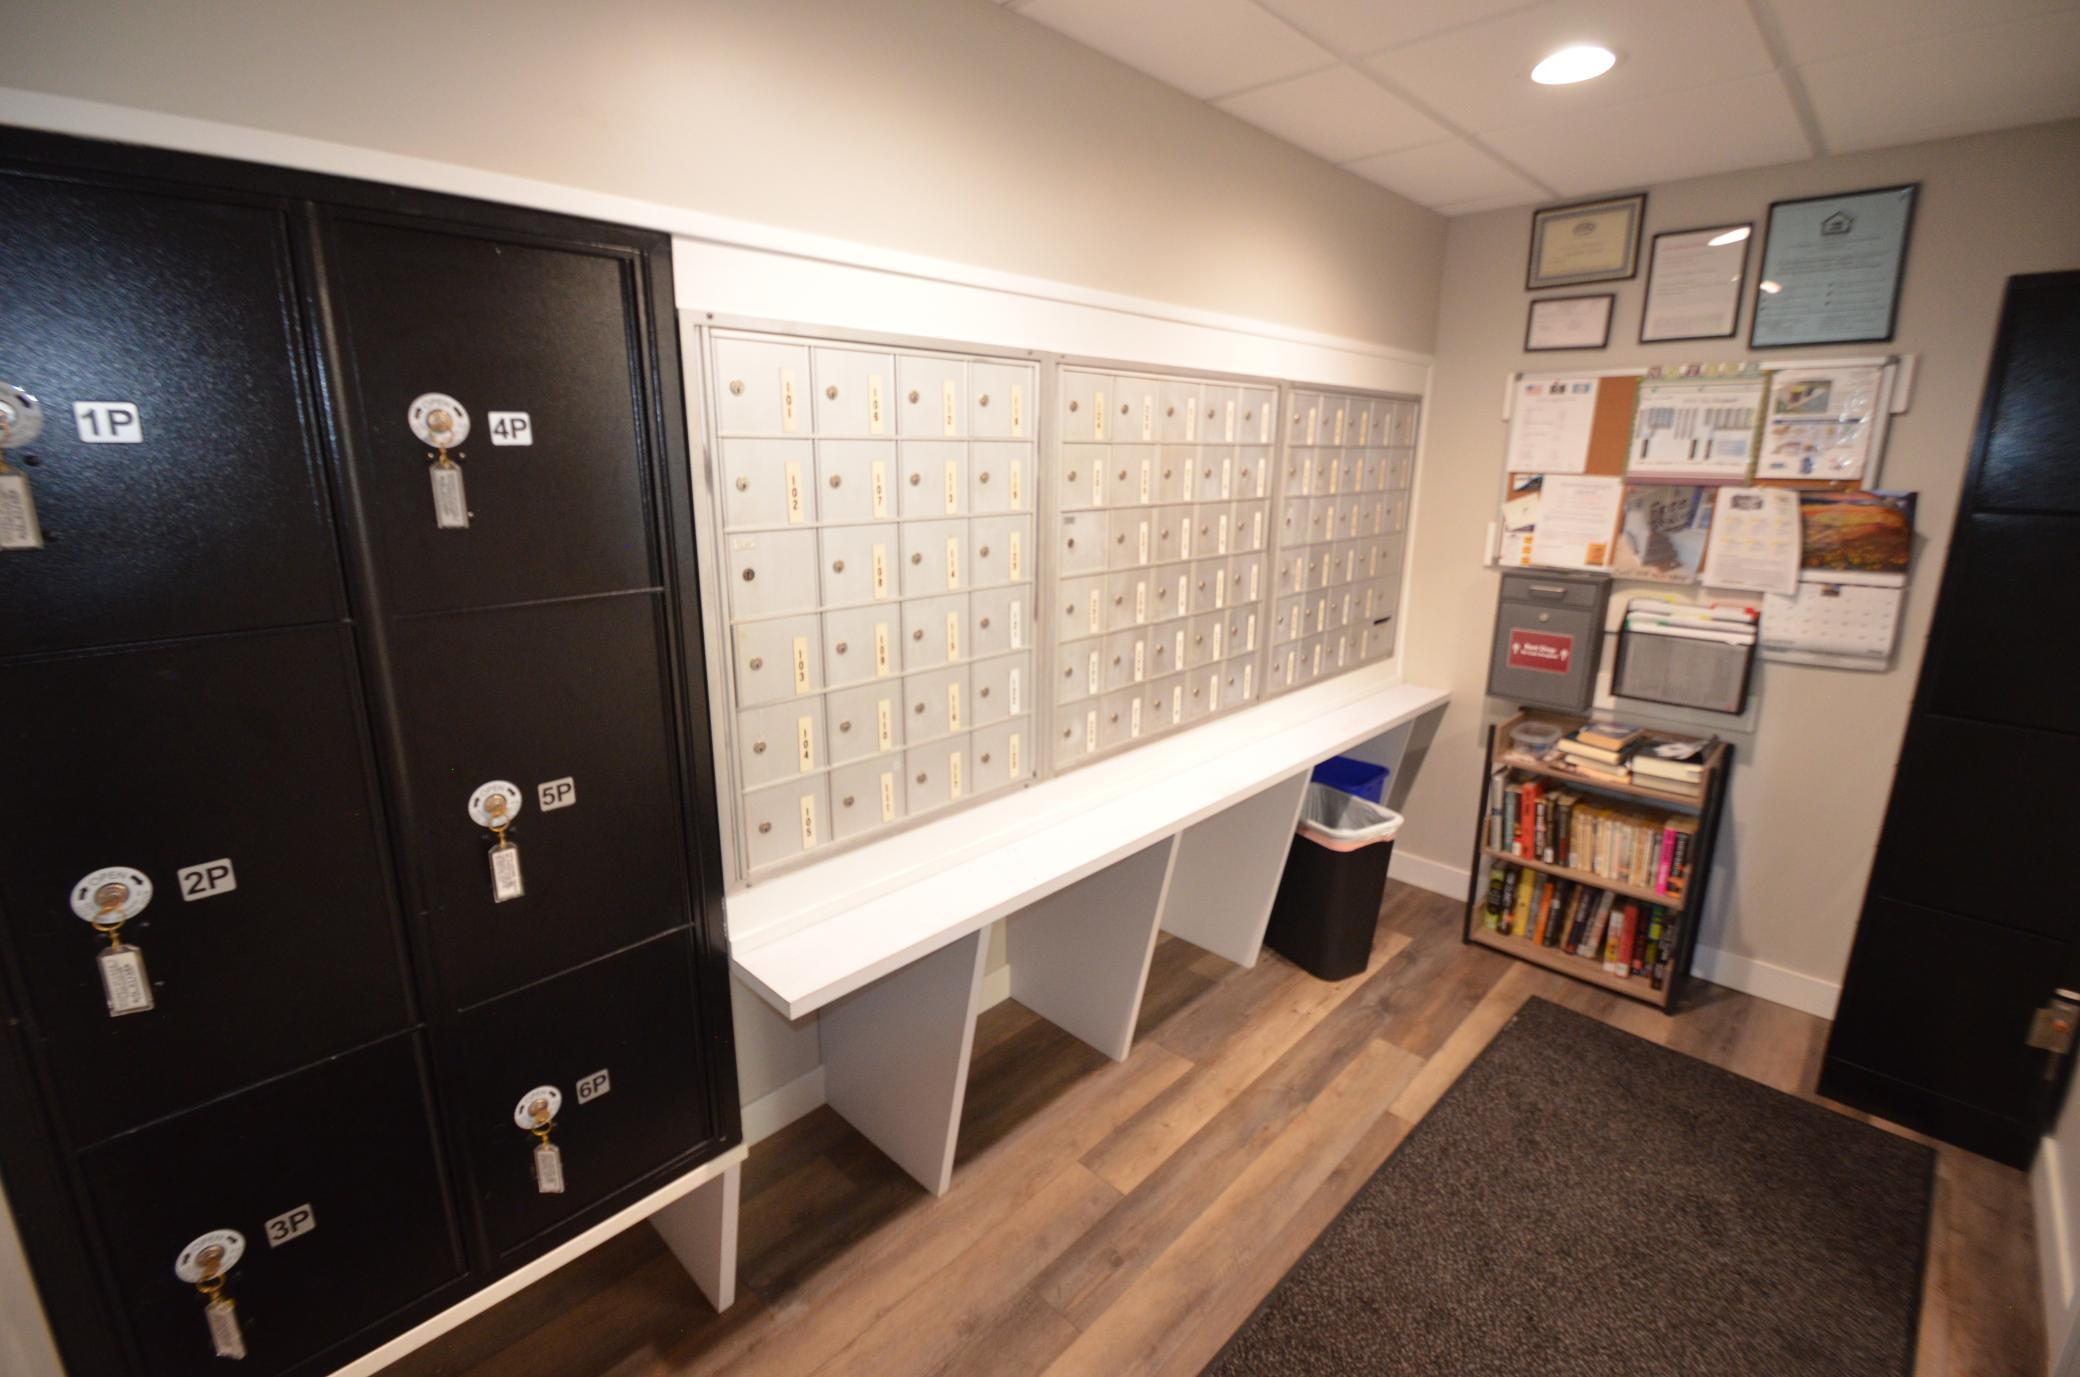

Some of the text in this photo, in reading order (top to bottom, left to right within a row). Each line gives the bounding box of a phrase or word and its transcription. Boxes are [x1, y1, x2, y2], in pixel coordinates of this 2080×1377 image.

[784, 381, 793, 420] 101
[83, 408, 134, 437] 1P
[493, 416, 527, 440] 4P
[791, 474, 799, 511] 102
[802, 727, 810, 760] 104
[479, 784, 505, 797] OPEN
[542, 782, 572, 806] 5P
[805, 807, 813, 837] 105
[87, 869, 129, 886] OPEN
[184, 865, 229, 896] 2P
[579, 1074, 607, 1098] 6P
[270, 1210, 309, 1240] 3P
